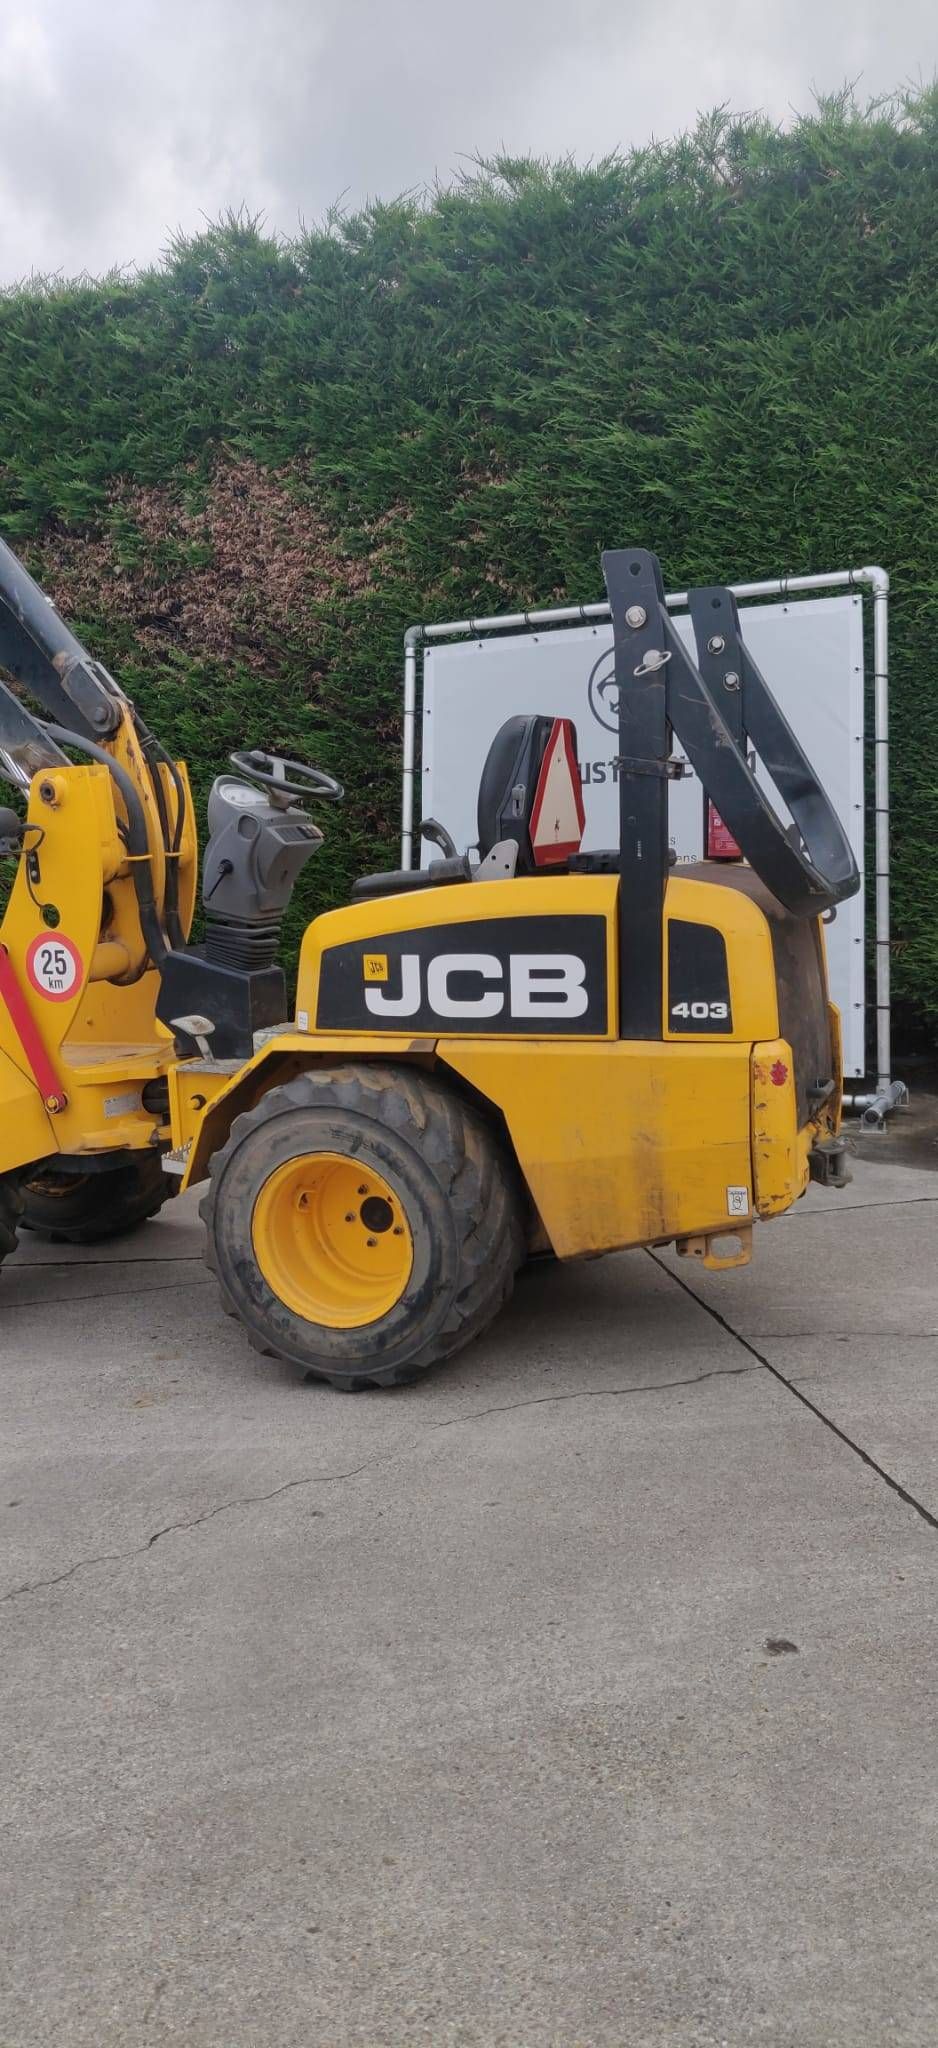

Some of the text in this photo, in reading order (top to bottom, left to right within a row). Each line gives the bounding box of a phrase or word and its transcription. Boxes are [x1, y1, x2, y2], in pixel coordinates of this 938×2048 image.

[41, 949, 67, 975] 25
[48, 976, 64, 989] km
[364, 953, 589, 1018] JCB
[671, 1002, 728, 1019] 403
